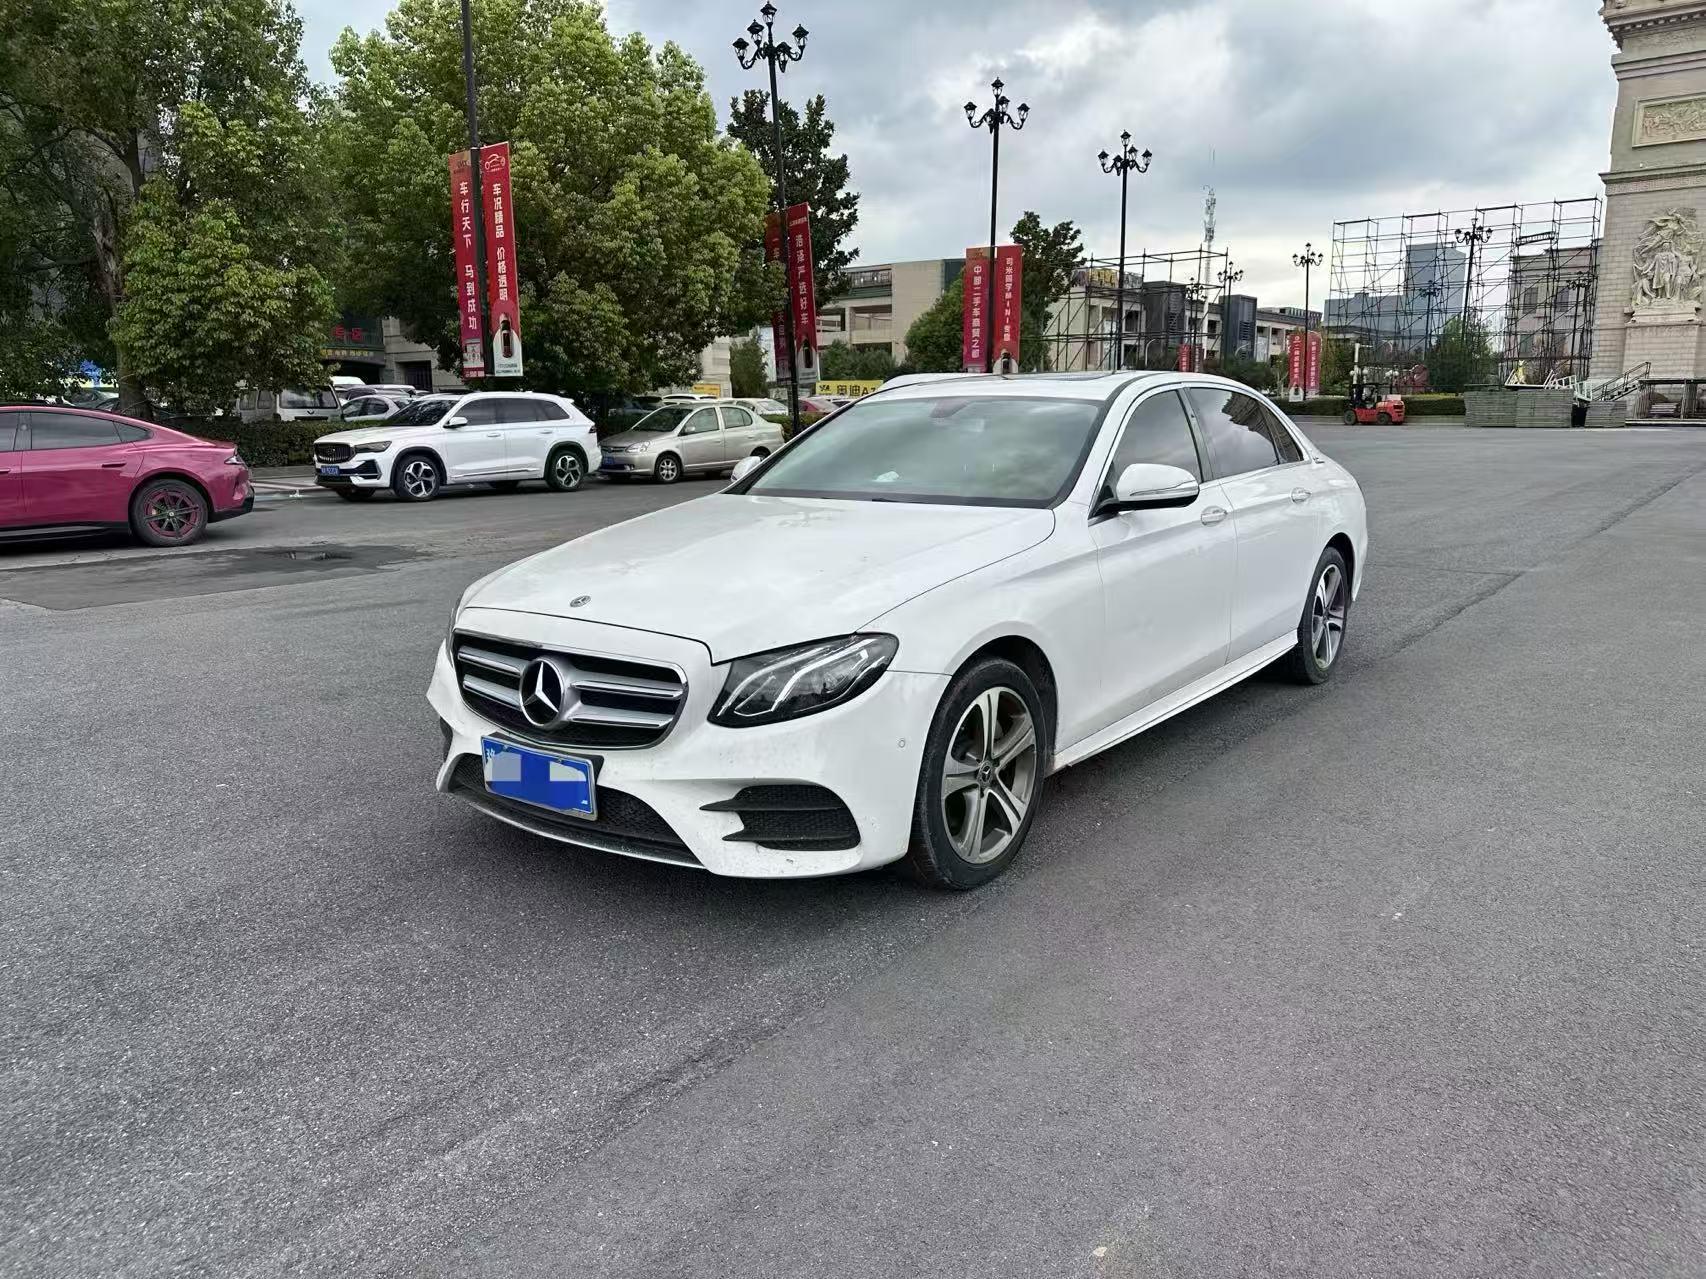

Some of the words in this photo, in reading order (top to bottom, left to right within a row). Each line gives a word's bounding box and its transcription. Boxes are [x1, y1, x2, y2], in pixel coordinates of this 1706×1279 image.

[459, 181, 472, 249] 车行天下
[492, 183, 505, 238] 车况精品
[464, 264, 477, 330] 马到成功
[496, 247, 508, 301] 价格透明
